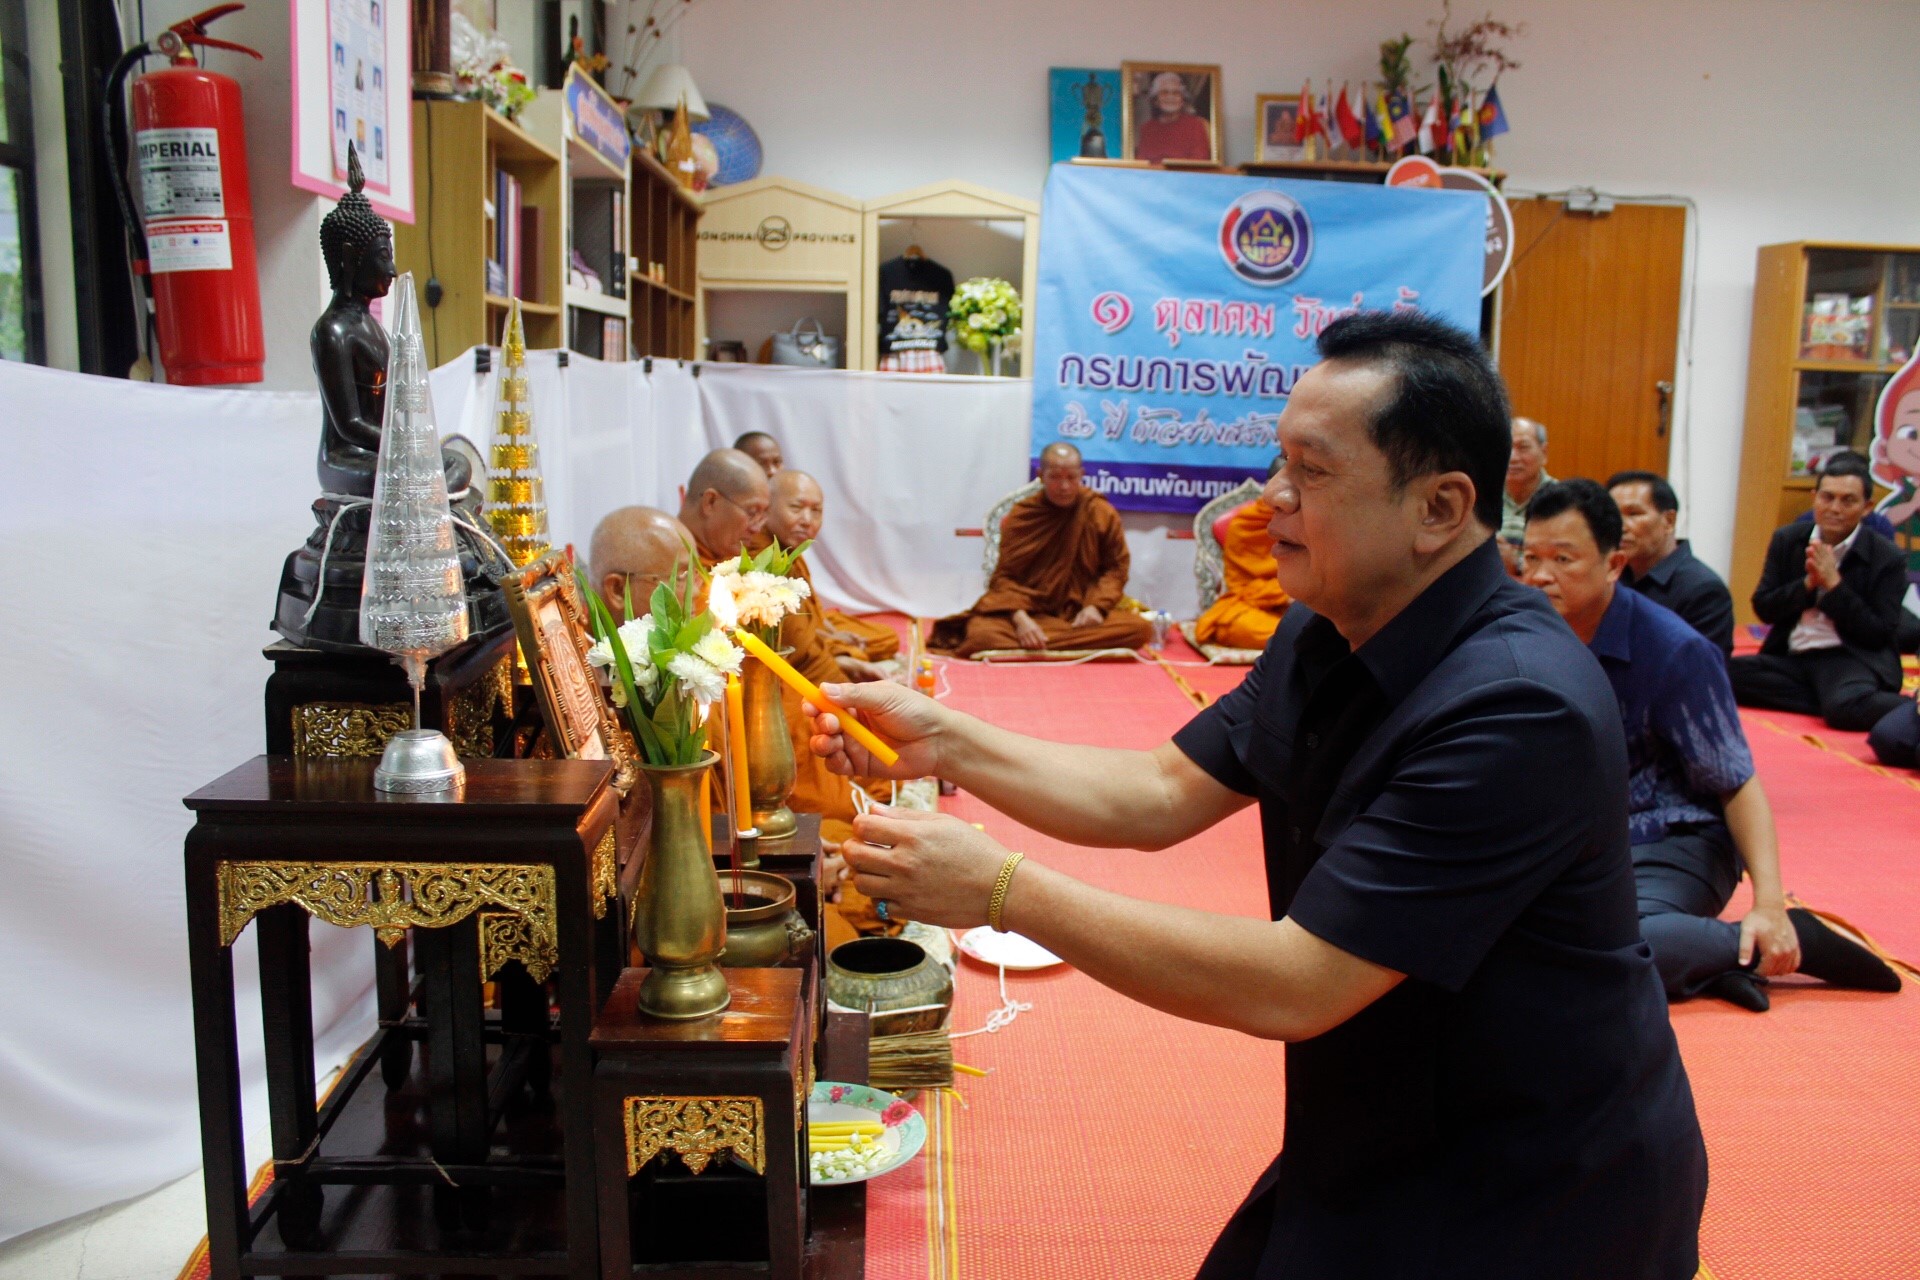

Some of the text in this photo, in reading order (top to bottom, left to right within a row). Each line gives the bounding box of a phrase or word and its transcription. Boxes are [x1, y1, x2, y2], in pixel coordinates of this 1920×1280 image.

[139, 141, 216, 160] MPERIAL
[793, 232, 856, 244] PROVINCE
[1154, 297, 1275, 348] ตุลาคม
[1102, 398, 1128, 439] ปี
